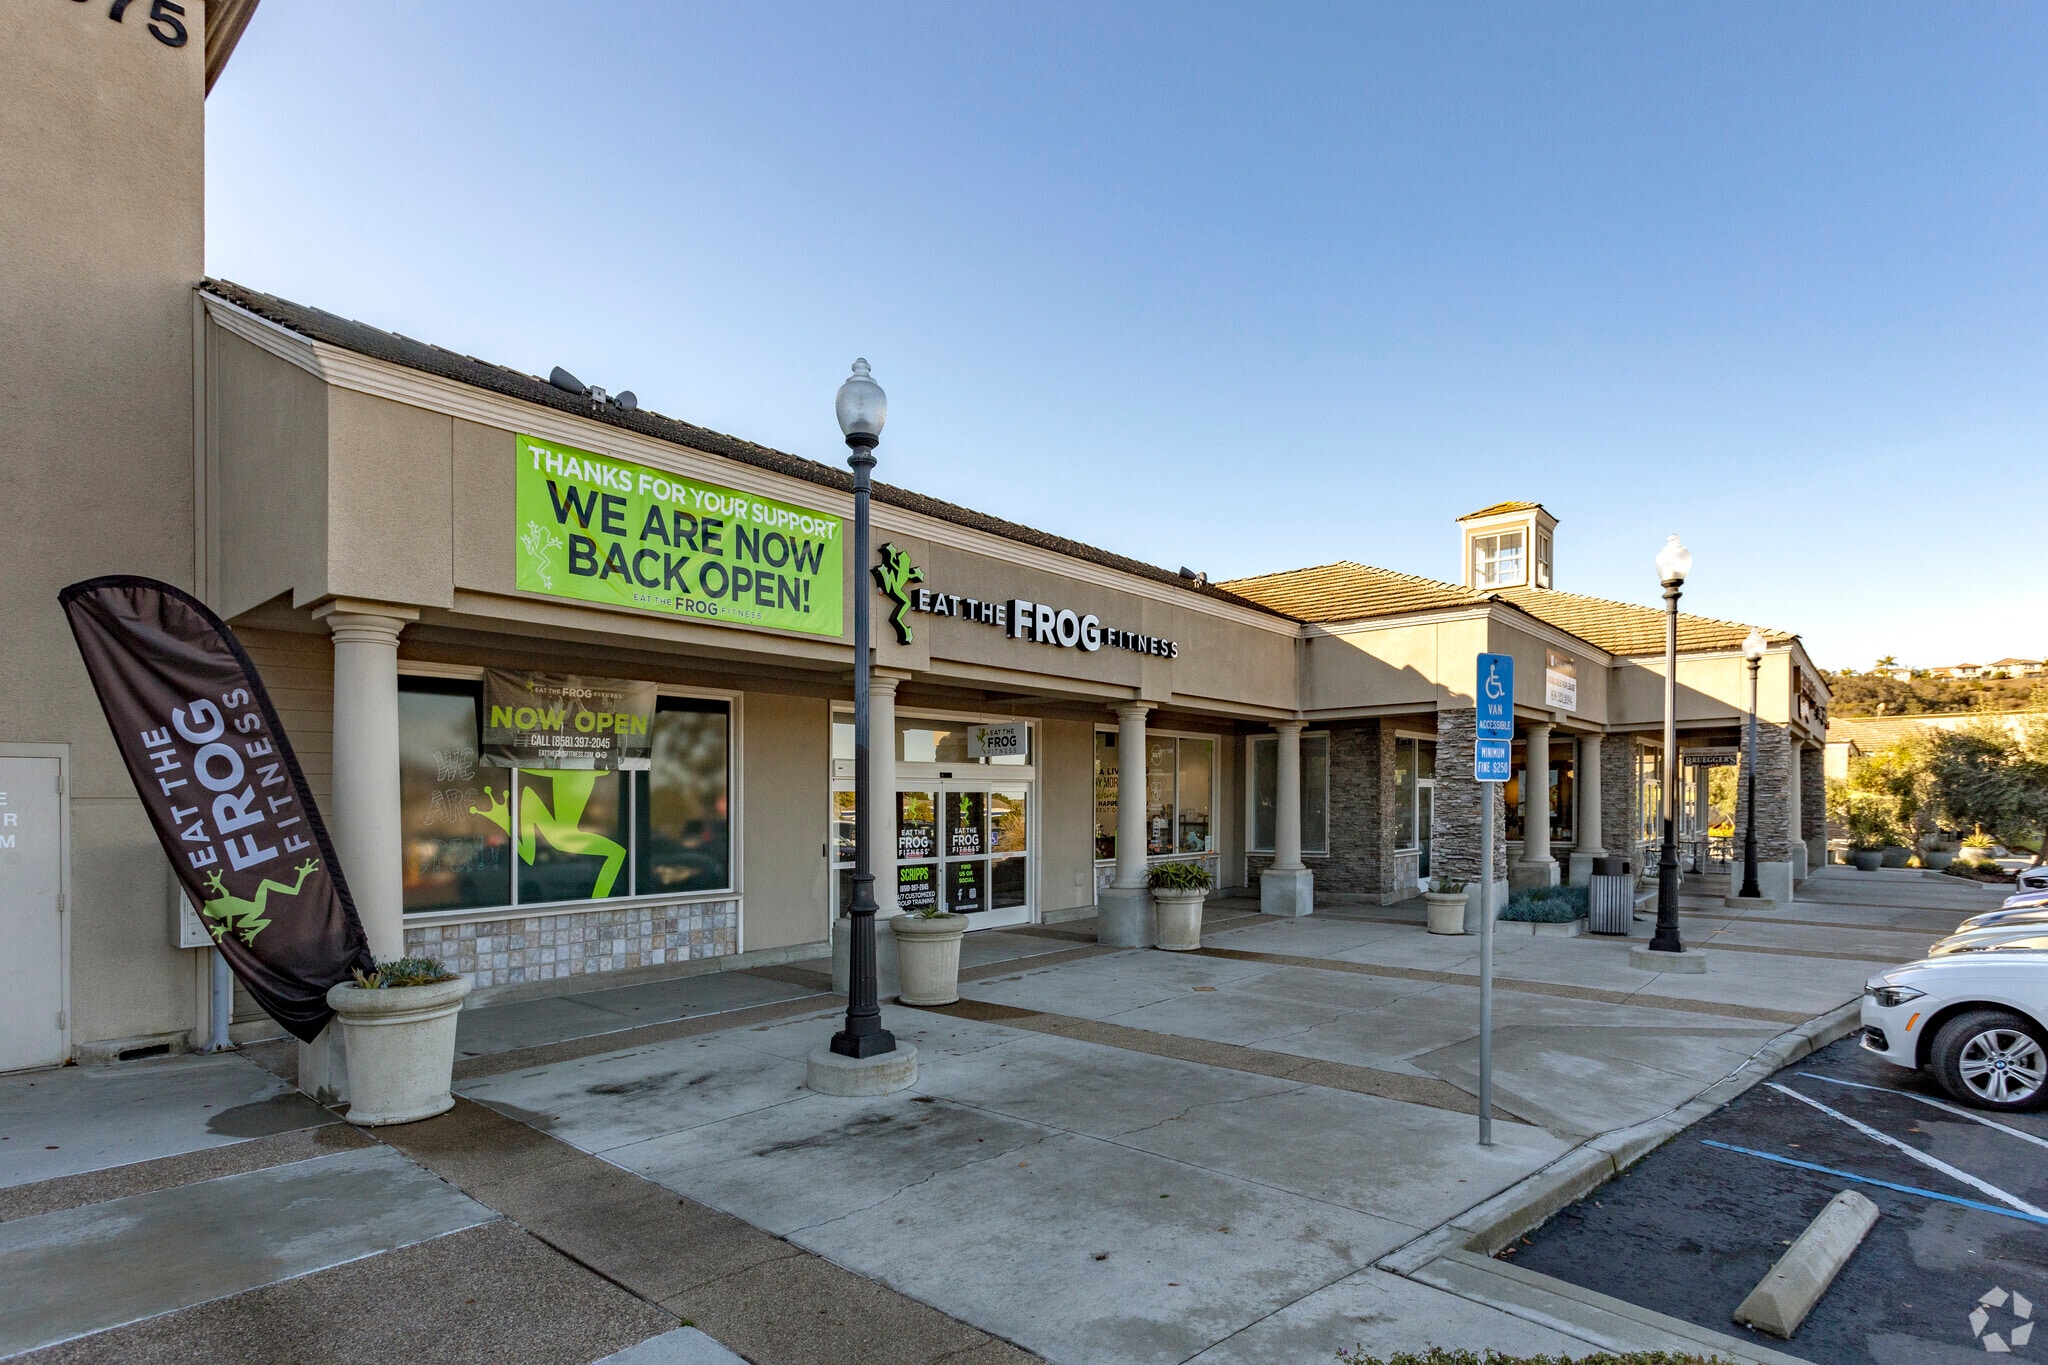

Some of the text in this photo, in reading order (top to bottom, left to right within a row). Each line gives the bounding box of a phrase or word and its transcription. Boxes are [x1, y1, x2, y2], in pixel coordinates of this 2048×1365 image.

[527, 445, 836, 540] THANKS FOR YOUR SUPPORT
[546, 479, 824, 575] WE ARE NOW
[569, 534, 810, 613] BACK OPEN!
[633, 593, 762, 620] EAT THE FROG FITNESS
[917, 588, 1179, 659] EAT THE FROG FITNESS
[562, 687, 592, 698] FROG
[593, 691, 622, 699] FITNESS
[1488, 704, 1503, 715] VAN
[490, 705, 648, 735] NOW OPEN
[1479, 720, 1511, 731] ACCESSIBLE
[531, 734, 550, 746] CALL
[574, 736, 610, 748] 397-2045
[988, 735, 1017, 748] FROG
[988, 747, 1017, 755] FITNESS
[1481, 747, 1505, 759] MINIMUM
[433, 748, 475, 781] WE
[1685, 756, 1736, 765] BRUEGGER'S
[222, 687, 311, 853] FITNESS
[1478, 762, 1508, 774] FINE $250
[171, 697, 279, 872] FROG
[141, 725, 219, 869] EAT THE
[424, 788, 479, 825] ARE
[899, 836, 929, 849] FROG
[952, 834, 979, 846] FROG
[898, 848, 929, 856] FITNESS
[952, 845, 980, 853] FITNESS
[900, 867, 929, 882] SCRIPPS
[912, 898, 935, 906] TRAINING
